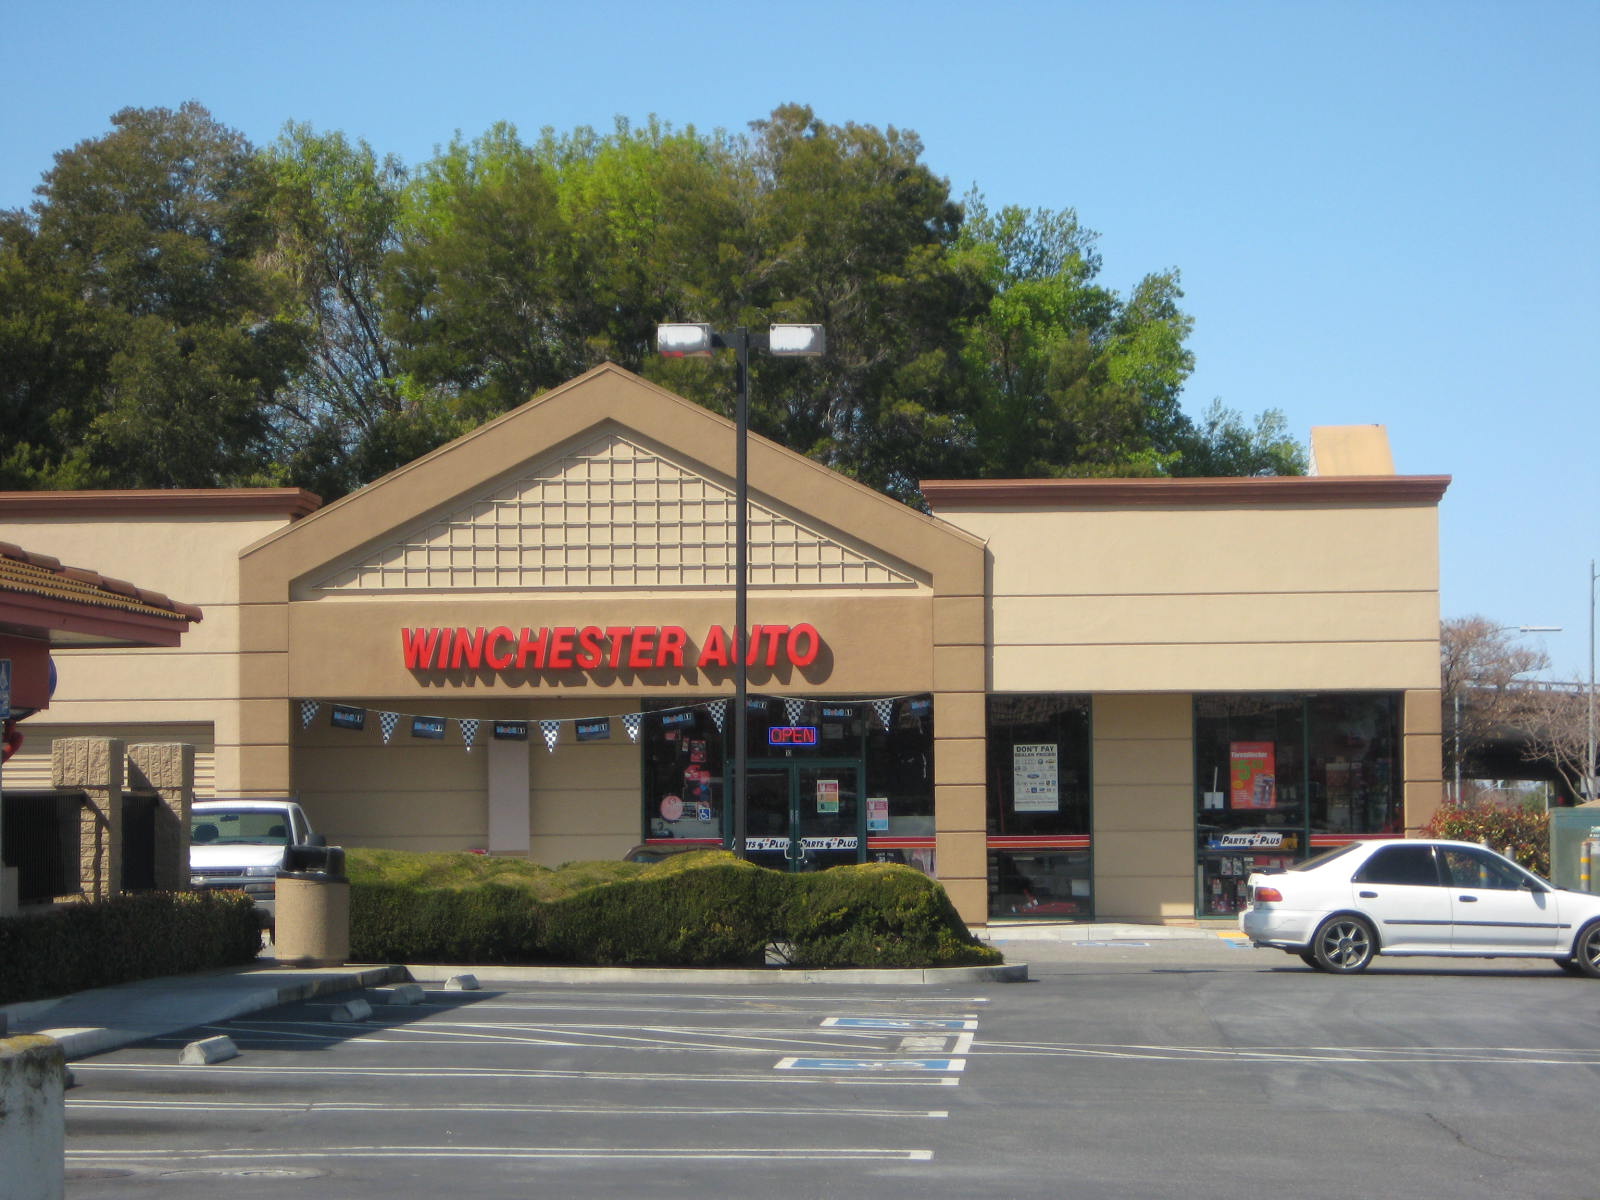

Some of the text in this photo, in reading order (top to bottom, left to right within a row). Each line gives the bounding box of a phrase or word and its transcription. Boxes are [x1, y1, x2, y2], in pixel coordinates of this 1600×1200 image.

[401, 623, 820, 670] WINCHESTER AUTO
[771, 728, 814, 743] OPEN
[1016, 745, 1038, 753] DON'T
[801, 839, 858, 848] PARTS PLUS
[1222, 835, 1281, 845] PARTS PLUS
